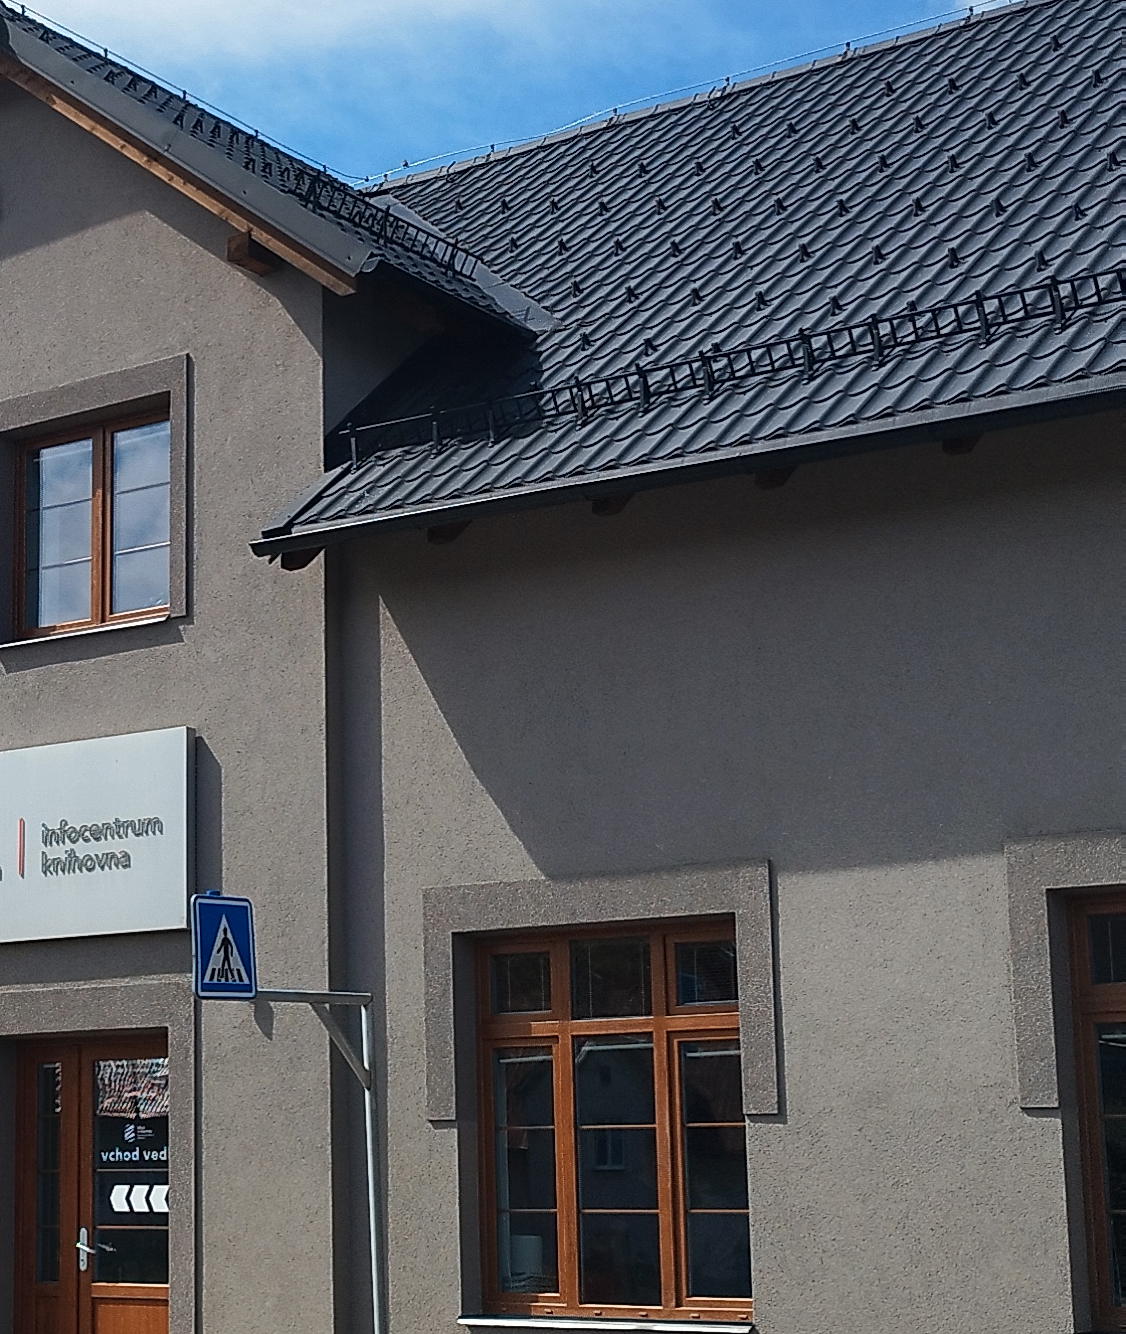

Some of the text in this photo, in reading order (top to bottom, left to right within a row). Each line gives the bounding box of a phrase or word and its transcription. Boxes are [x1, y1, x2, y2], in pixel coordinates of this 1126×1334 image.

[41, 816, 164, 848] infocentrum
[41, 848, 131, 877] knihovna
[100, 1146, 140, 1162] vchod
